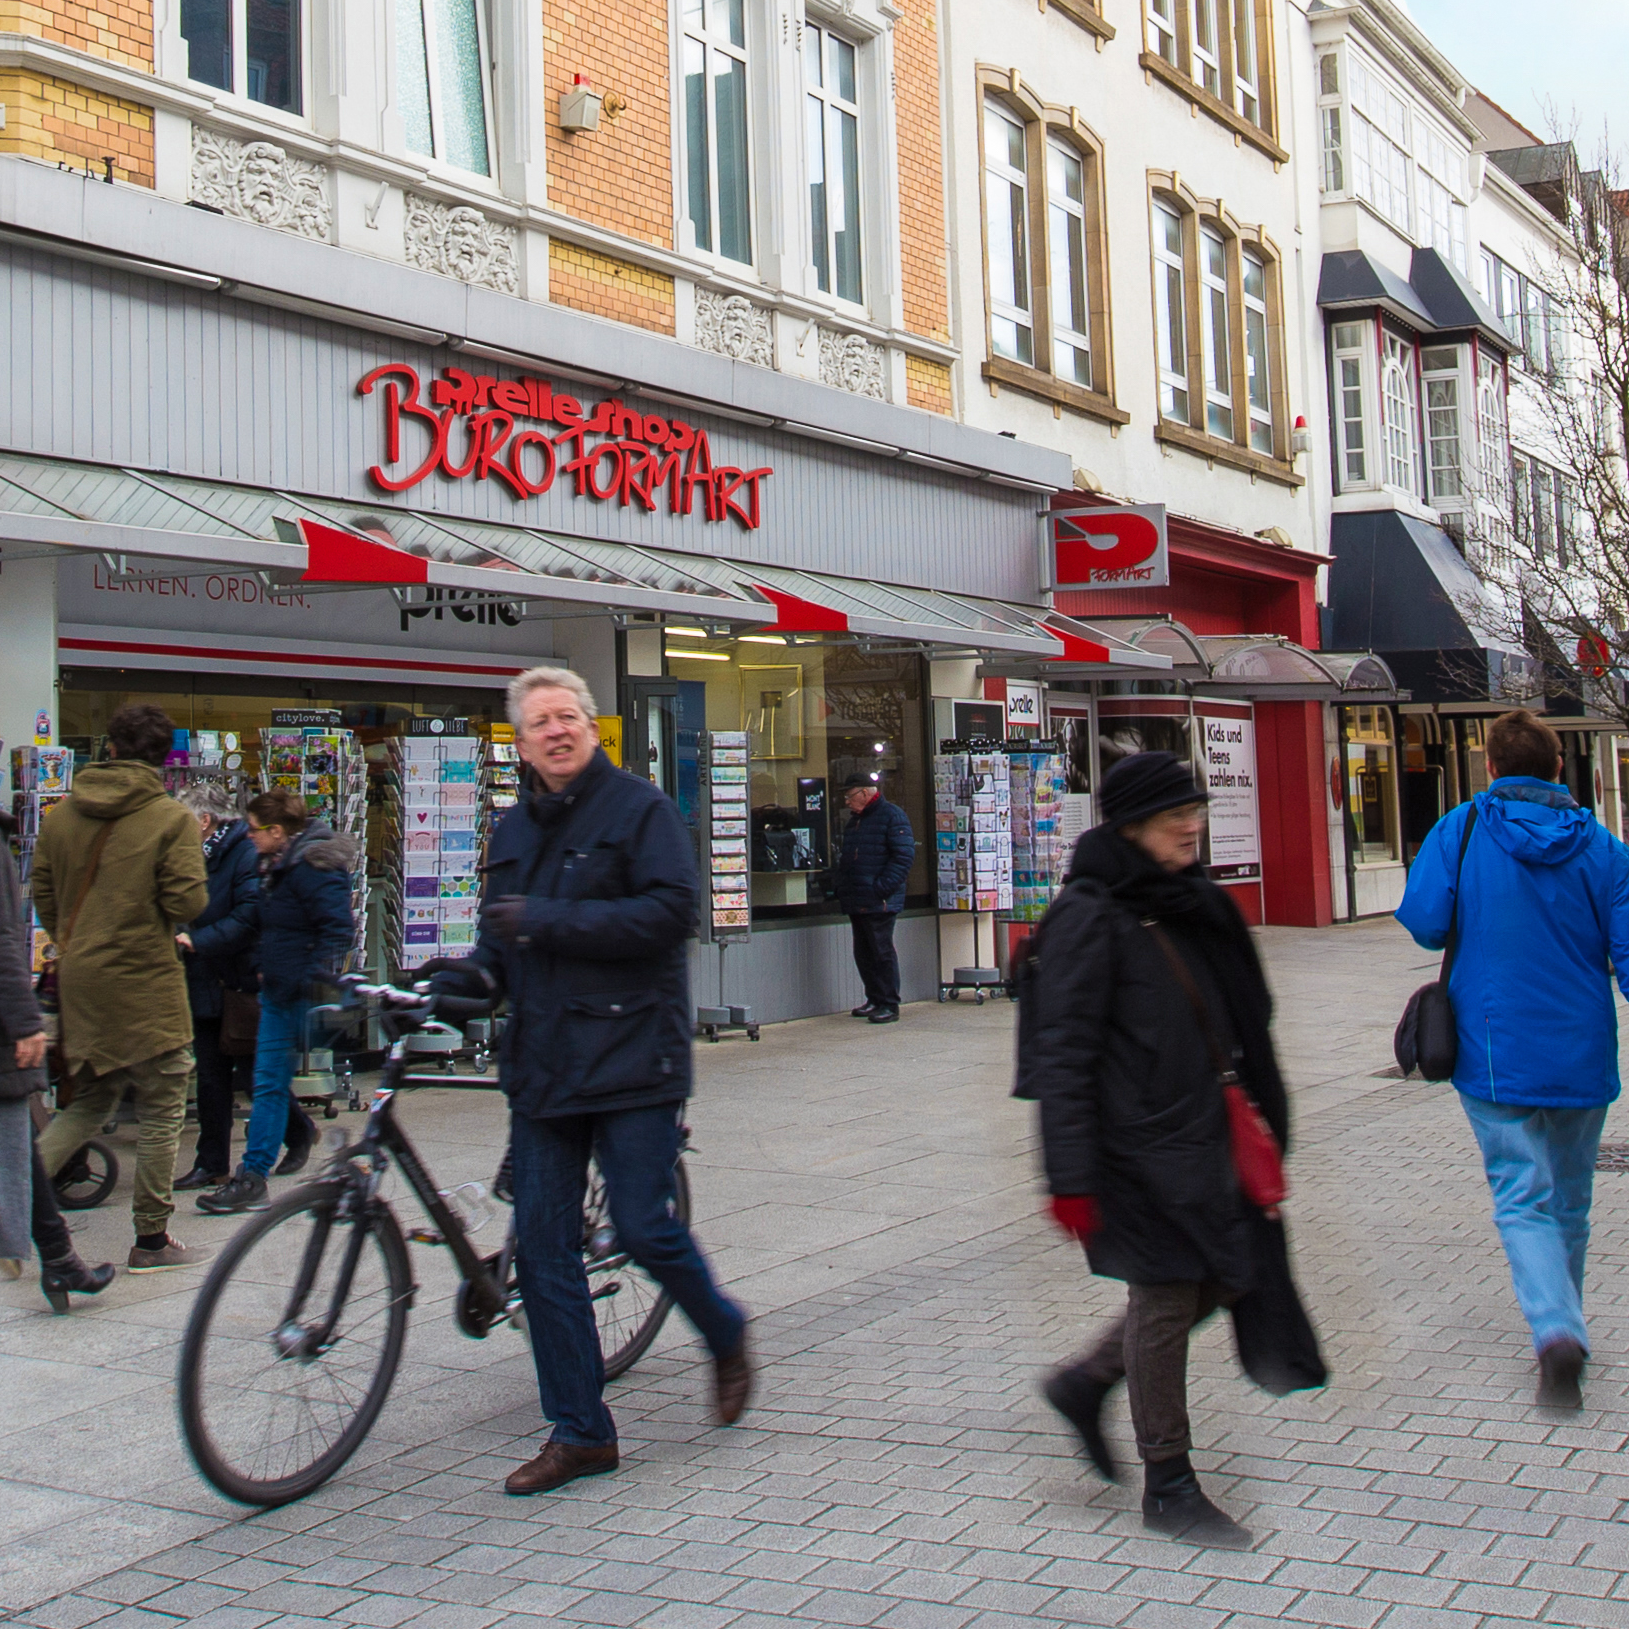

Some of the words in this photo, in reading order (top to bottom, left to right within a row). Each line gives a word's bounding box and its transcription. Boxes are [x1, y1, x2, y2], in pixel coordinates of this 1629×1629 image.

[92, 563, 197, 599] LERNEN.
[1009, 694, 1034, 717] prelle
[275, 713, 325, 724] citylove.
[412, 719, 430, 733] LUFT
[445, 719, 465, 733] LIEBE
[1207, 723, 1225, 743] Kids
[1227, 725, 1243, 743] und
[1207, 746, 1231, 766] Teens
[1209, 768, 1236, 788] zahlen
[1237, 769, 1253, 789] nix.
